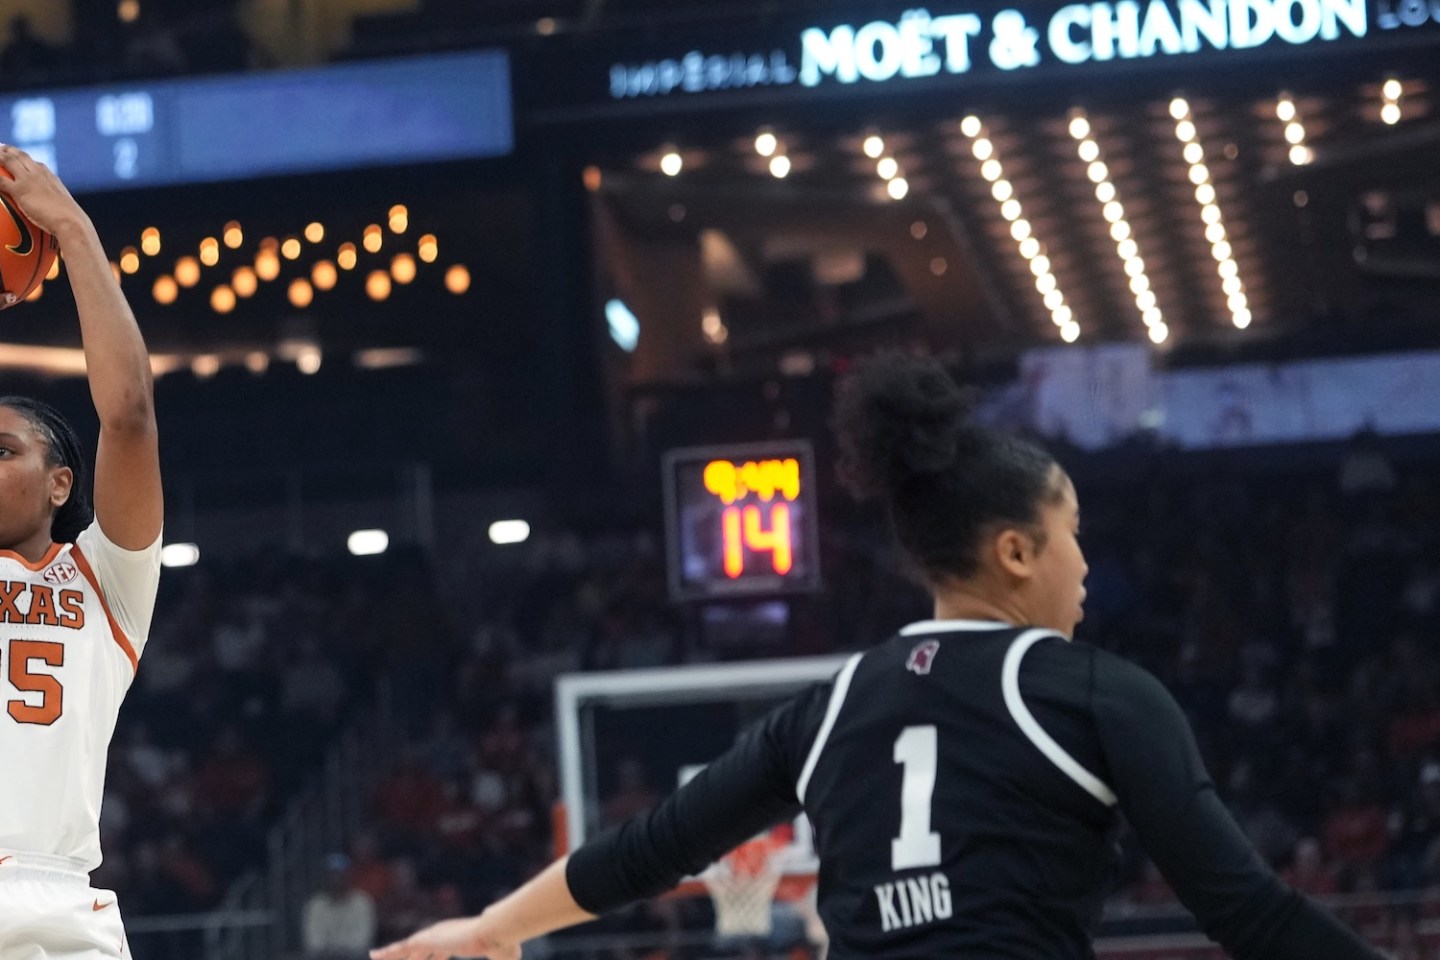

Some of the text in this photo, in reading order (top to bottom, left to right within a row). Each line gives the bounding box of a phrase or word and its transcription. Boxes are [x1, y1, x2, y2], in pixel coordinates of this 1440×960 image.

[799, 9, 981, 87] MOËT
[989, 9, 1039, 71] &
[1047, 0, 1368, 64] CHANDON
[44, 563, 76, 584] SEC
[721, 502, 792, 579] 14
[891, 725, 941, 871] 1
[874, 872, 952, 932] KING
